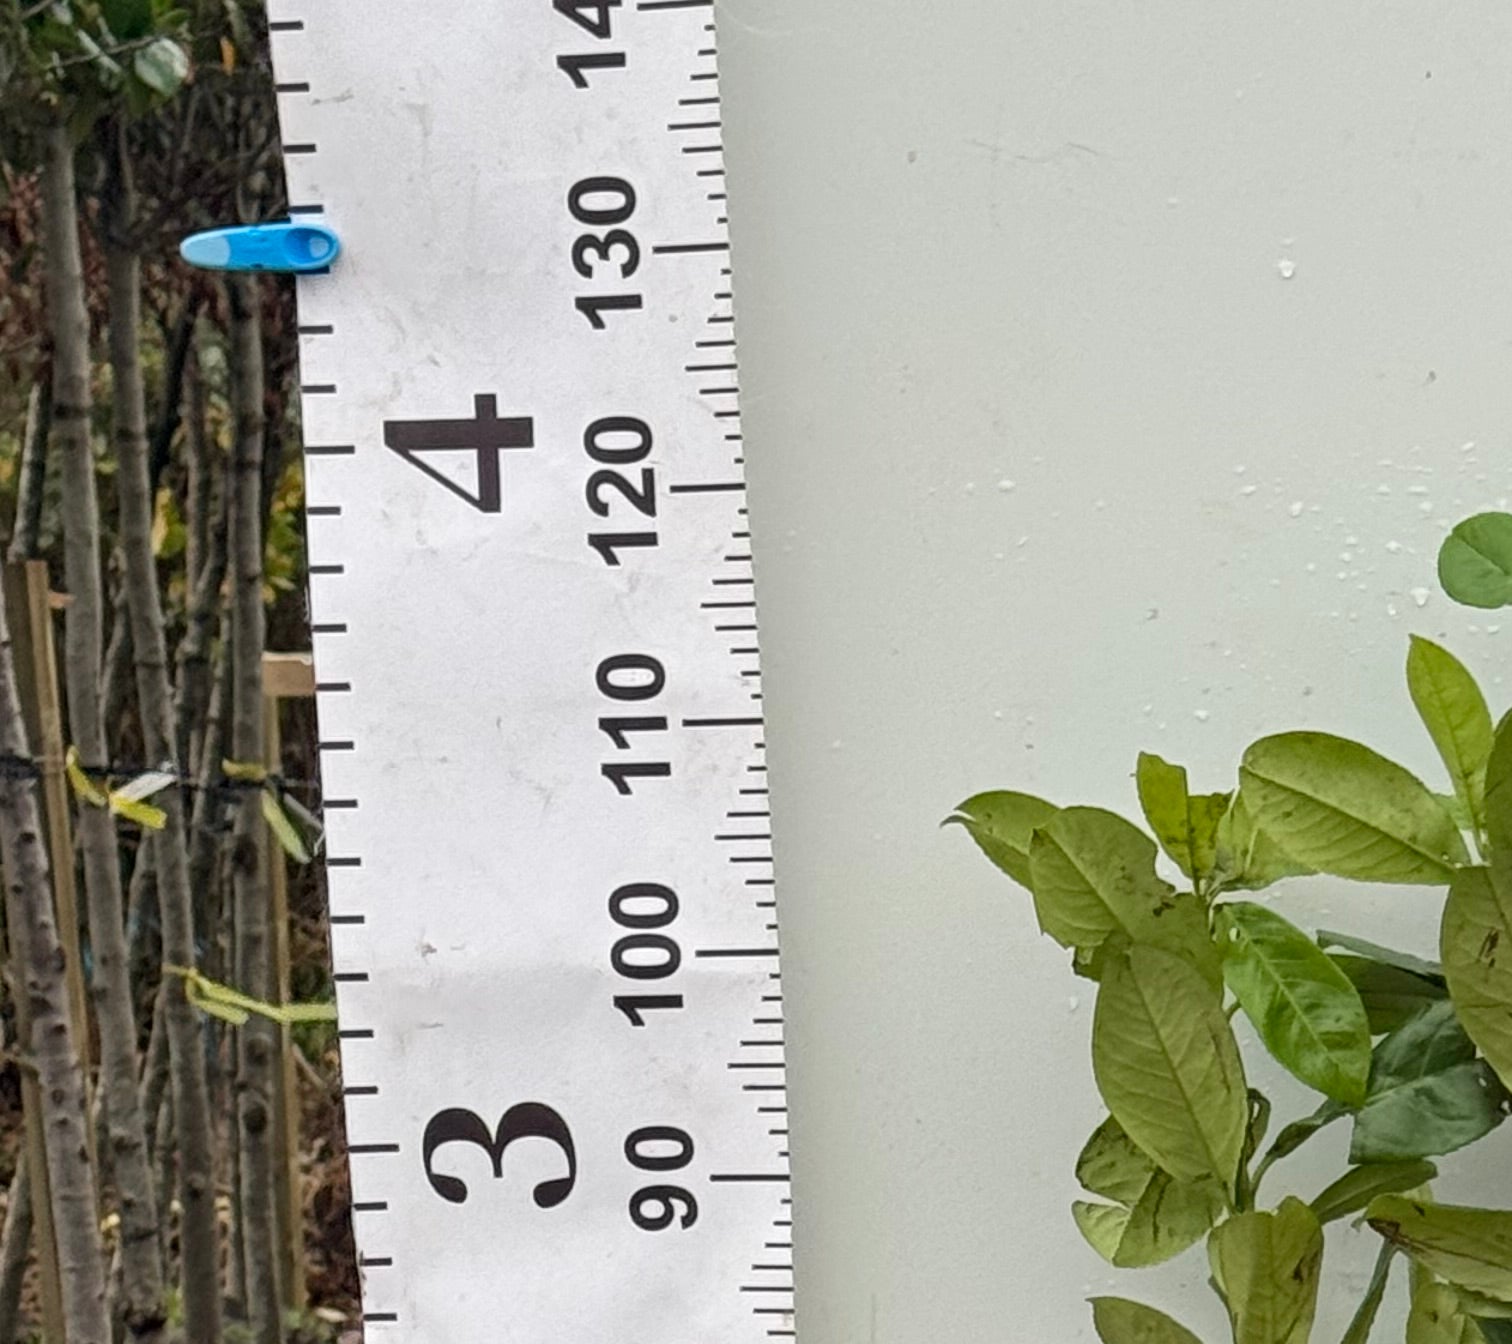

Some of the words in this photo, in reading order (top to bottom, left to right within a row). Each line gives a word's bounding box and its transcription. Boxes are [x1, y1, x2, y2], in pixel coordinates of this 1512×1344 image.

[554, 0, 626, 88] 14
[568, 177, 643, 329] 130
[384, 393, 534, 513] 4
[585, 416, 658, 566] 120
[596, 653, 671, 795] 110
[609, 882, 684, 1027] 100
[422, 1101, 577, 1209] 3
[625, 1125, 698, 1232] 90
